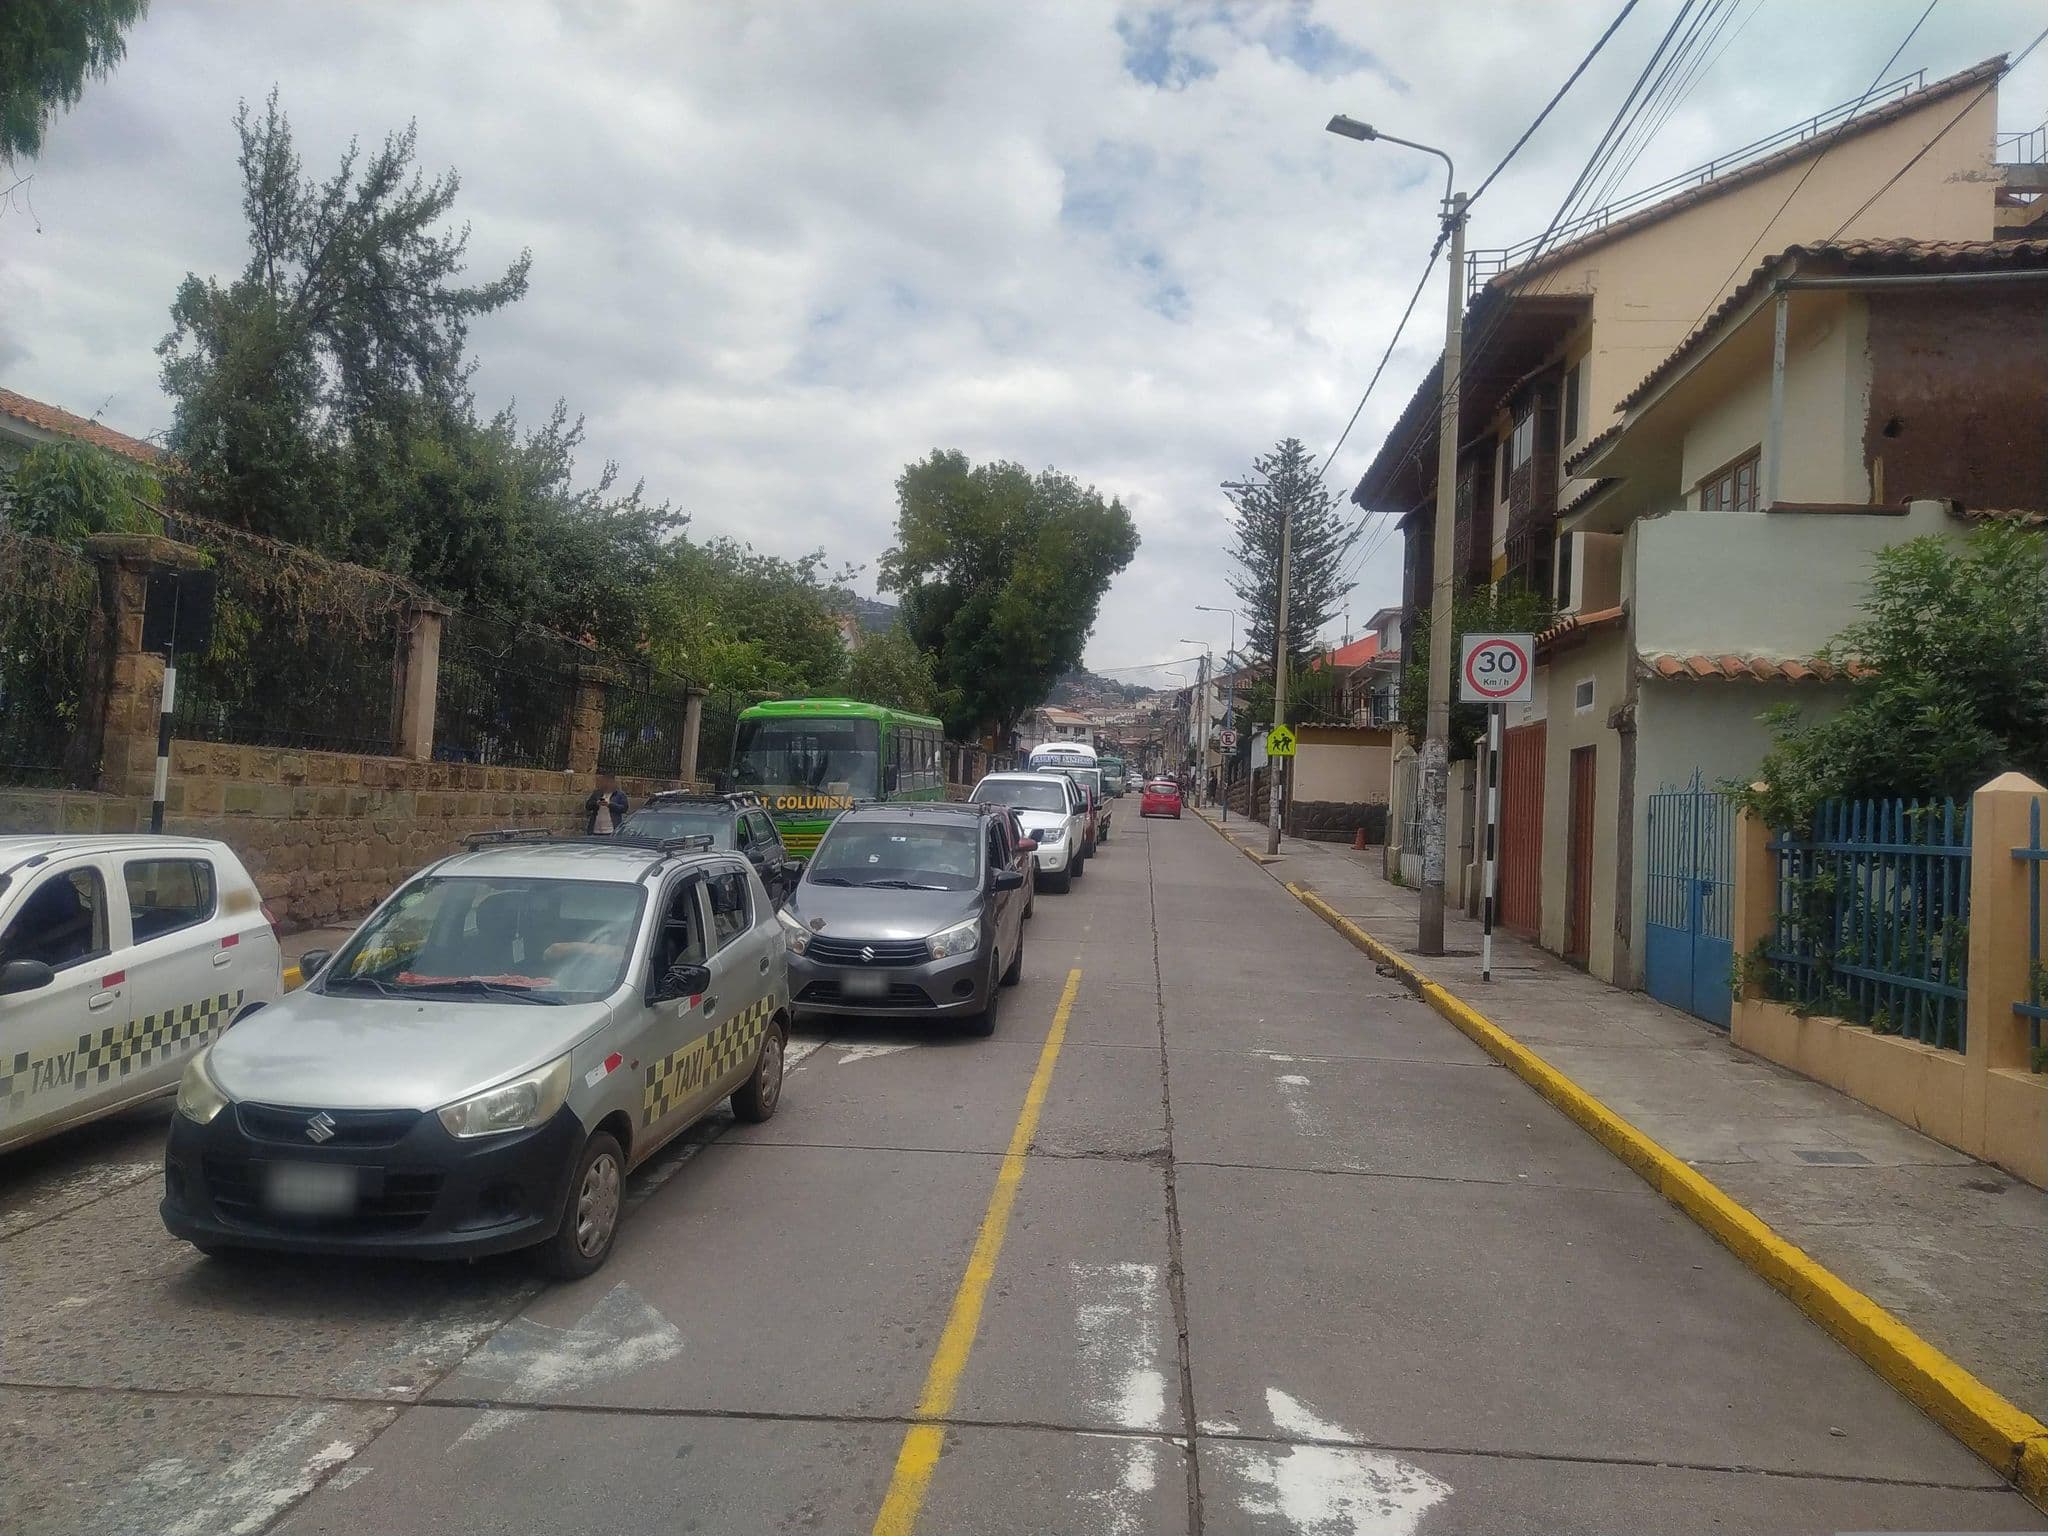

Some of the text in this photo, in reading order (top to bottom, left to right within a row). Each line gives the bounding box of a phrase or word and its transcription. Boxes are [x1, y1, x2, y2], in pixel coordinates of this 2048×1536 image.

[1478, 651, 1517, 673] 30
[776, 795, 854, 810] COLUMBIA
[31, 1050, 76, 1095] TAXI
[674, 1046, 705, 1098] TAXI
